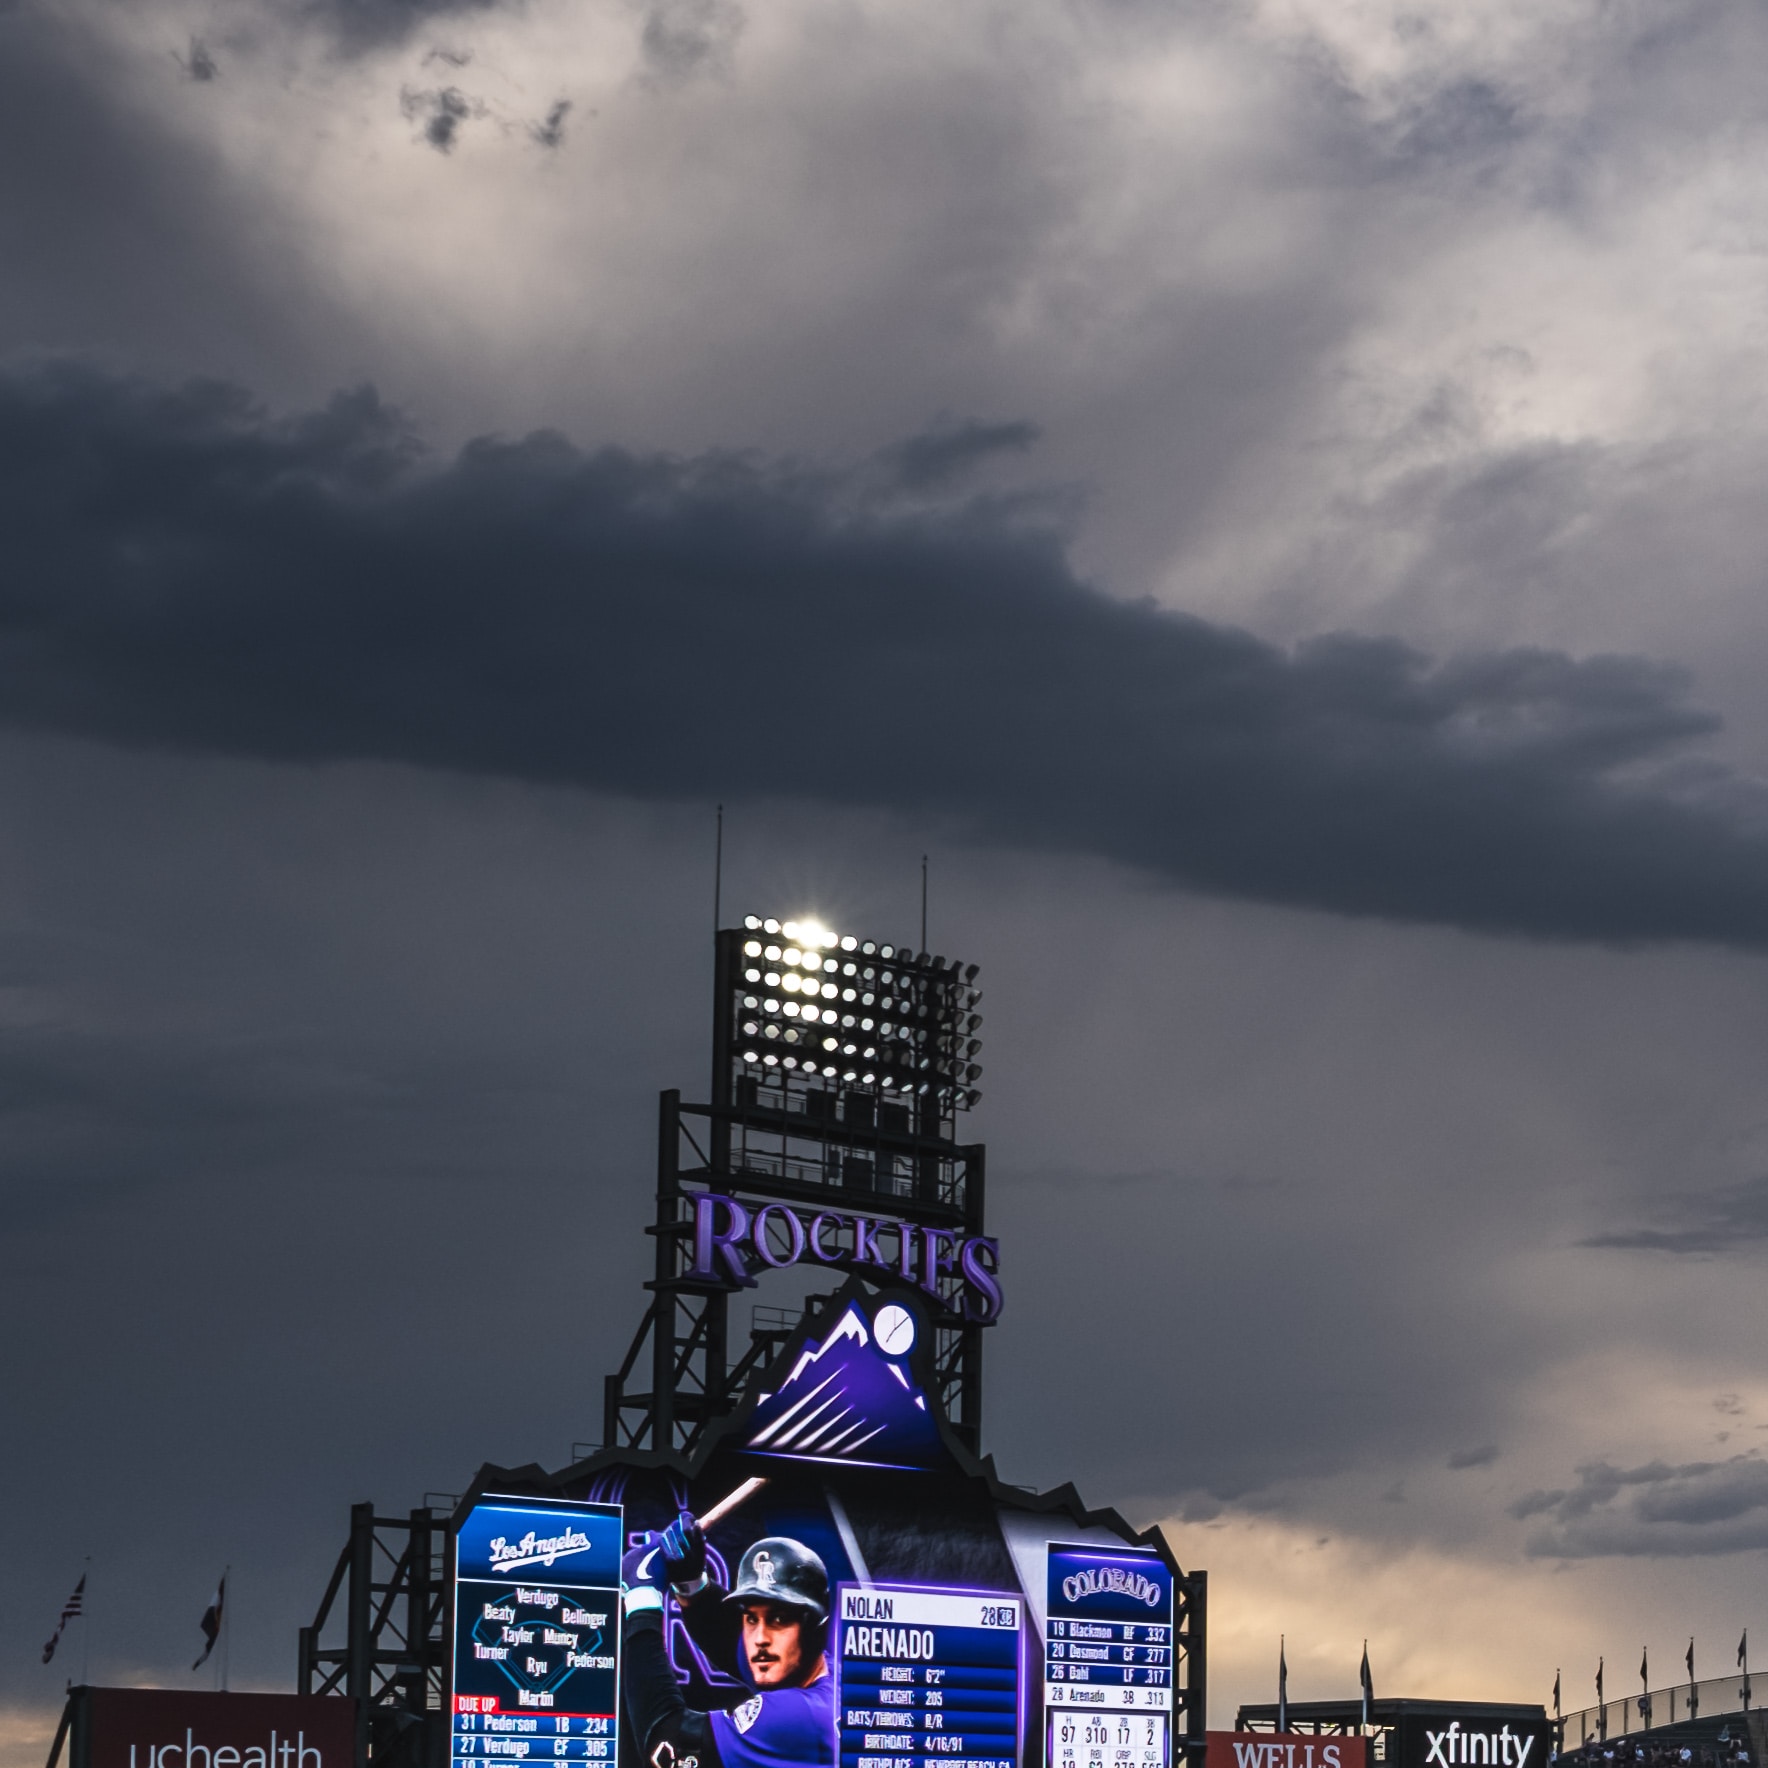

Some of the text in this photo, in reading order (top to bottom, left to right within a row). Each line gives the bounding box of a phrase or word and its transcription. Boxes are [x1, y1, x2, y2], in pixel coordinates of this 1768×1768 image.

[684, 1190, 1004, 1323] ROCKIES
[489, 1527, 591, 1566] Los Angeles
[1063, 1567, 1161, 1606] COLORADO
[516, 1588, 559, 1609] Verdugo
[483, 1603, 516, 1624] Beaty
[562, 1608, 608, 1629] Bellinger
[847, 1596, 996, 1625] NOLAN 28
[502, 1627, 535, 1646] Taylor
[544, 1629, 578, 1649] Muncy
[844, 1626, 934, 1659] ARENADO
[474, 1643, 509, 1660] Turner
[567, 1651, 615, 1669] Pederson
[527, 1657, 547, 1676] Ryu
[458, 1698, 495, 1712] DUE UP
[519, 1689, 554, 1707] Martin
[484, 1716, 537, 1732] Pederson
